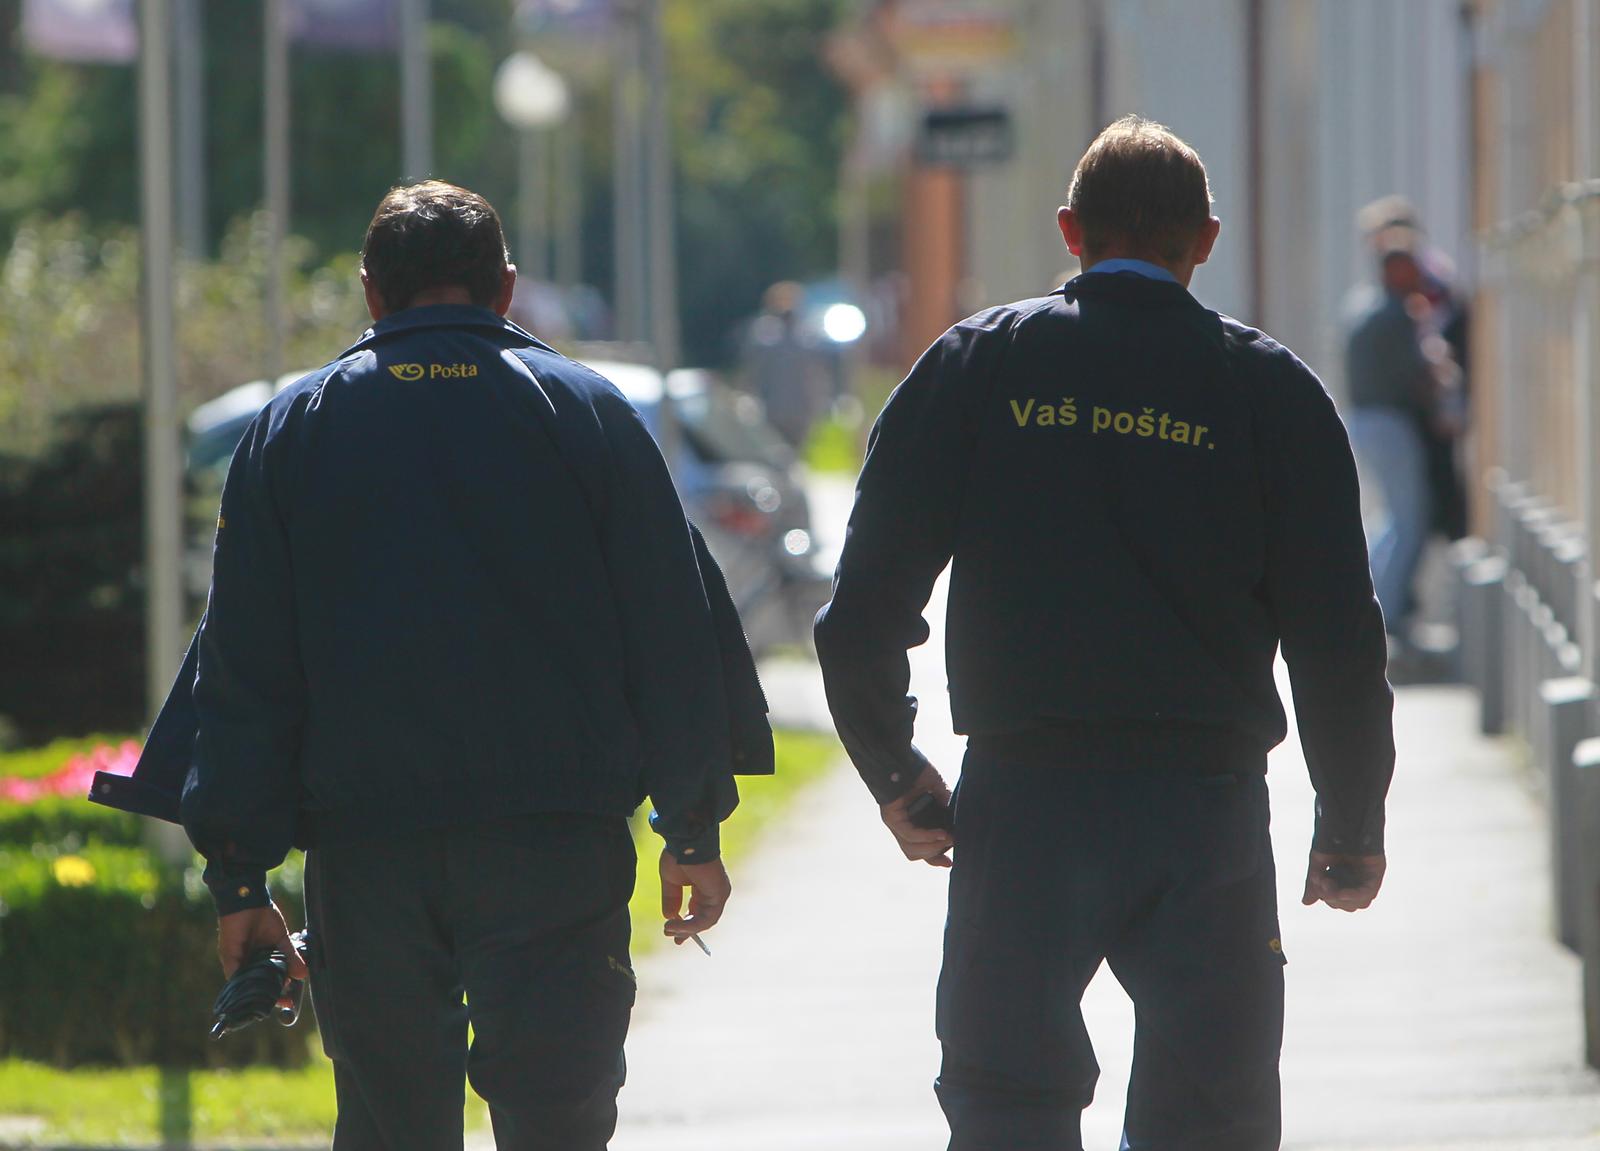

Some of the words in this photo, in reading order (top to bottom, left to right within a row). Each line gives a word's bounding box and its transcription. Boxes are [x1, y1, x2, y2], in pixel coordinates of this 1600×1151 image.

[430, 363, 478, 379] Pošta
[1009, 397, 1077, 427] Vaš
[1092, 406, 1214, 450] poštar.
